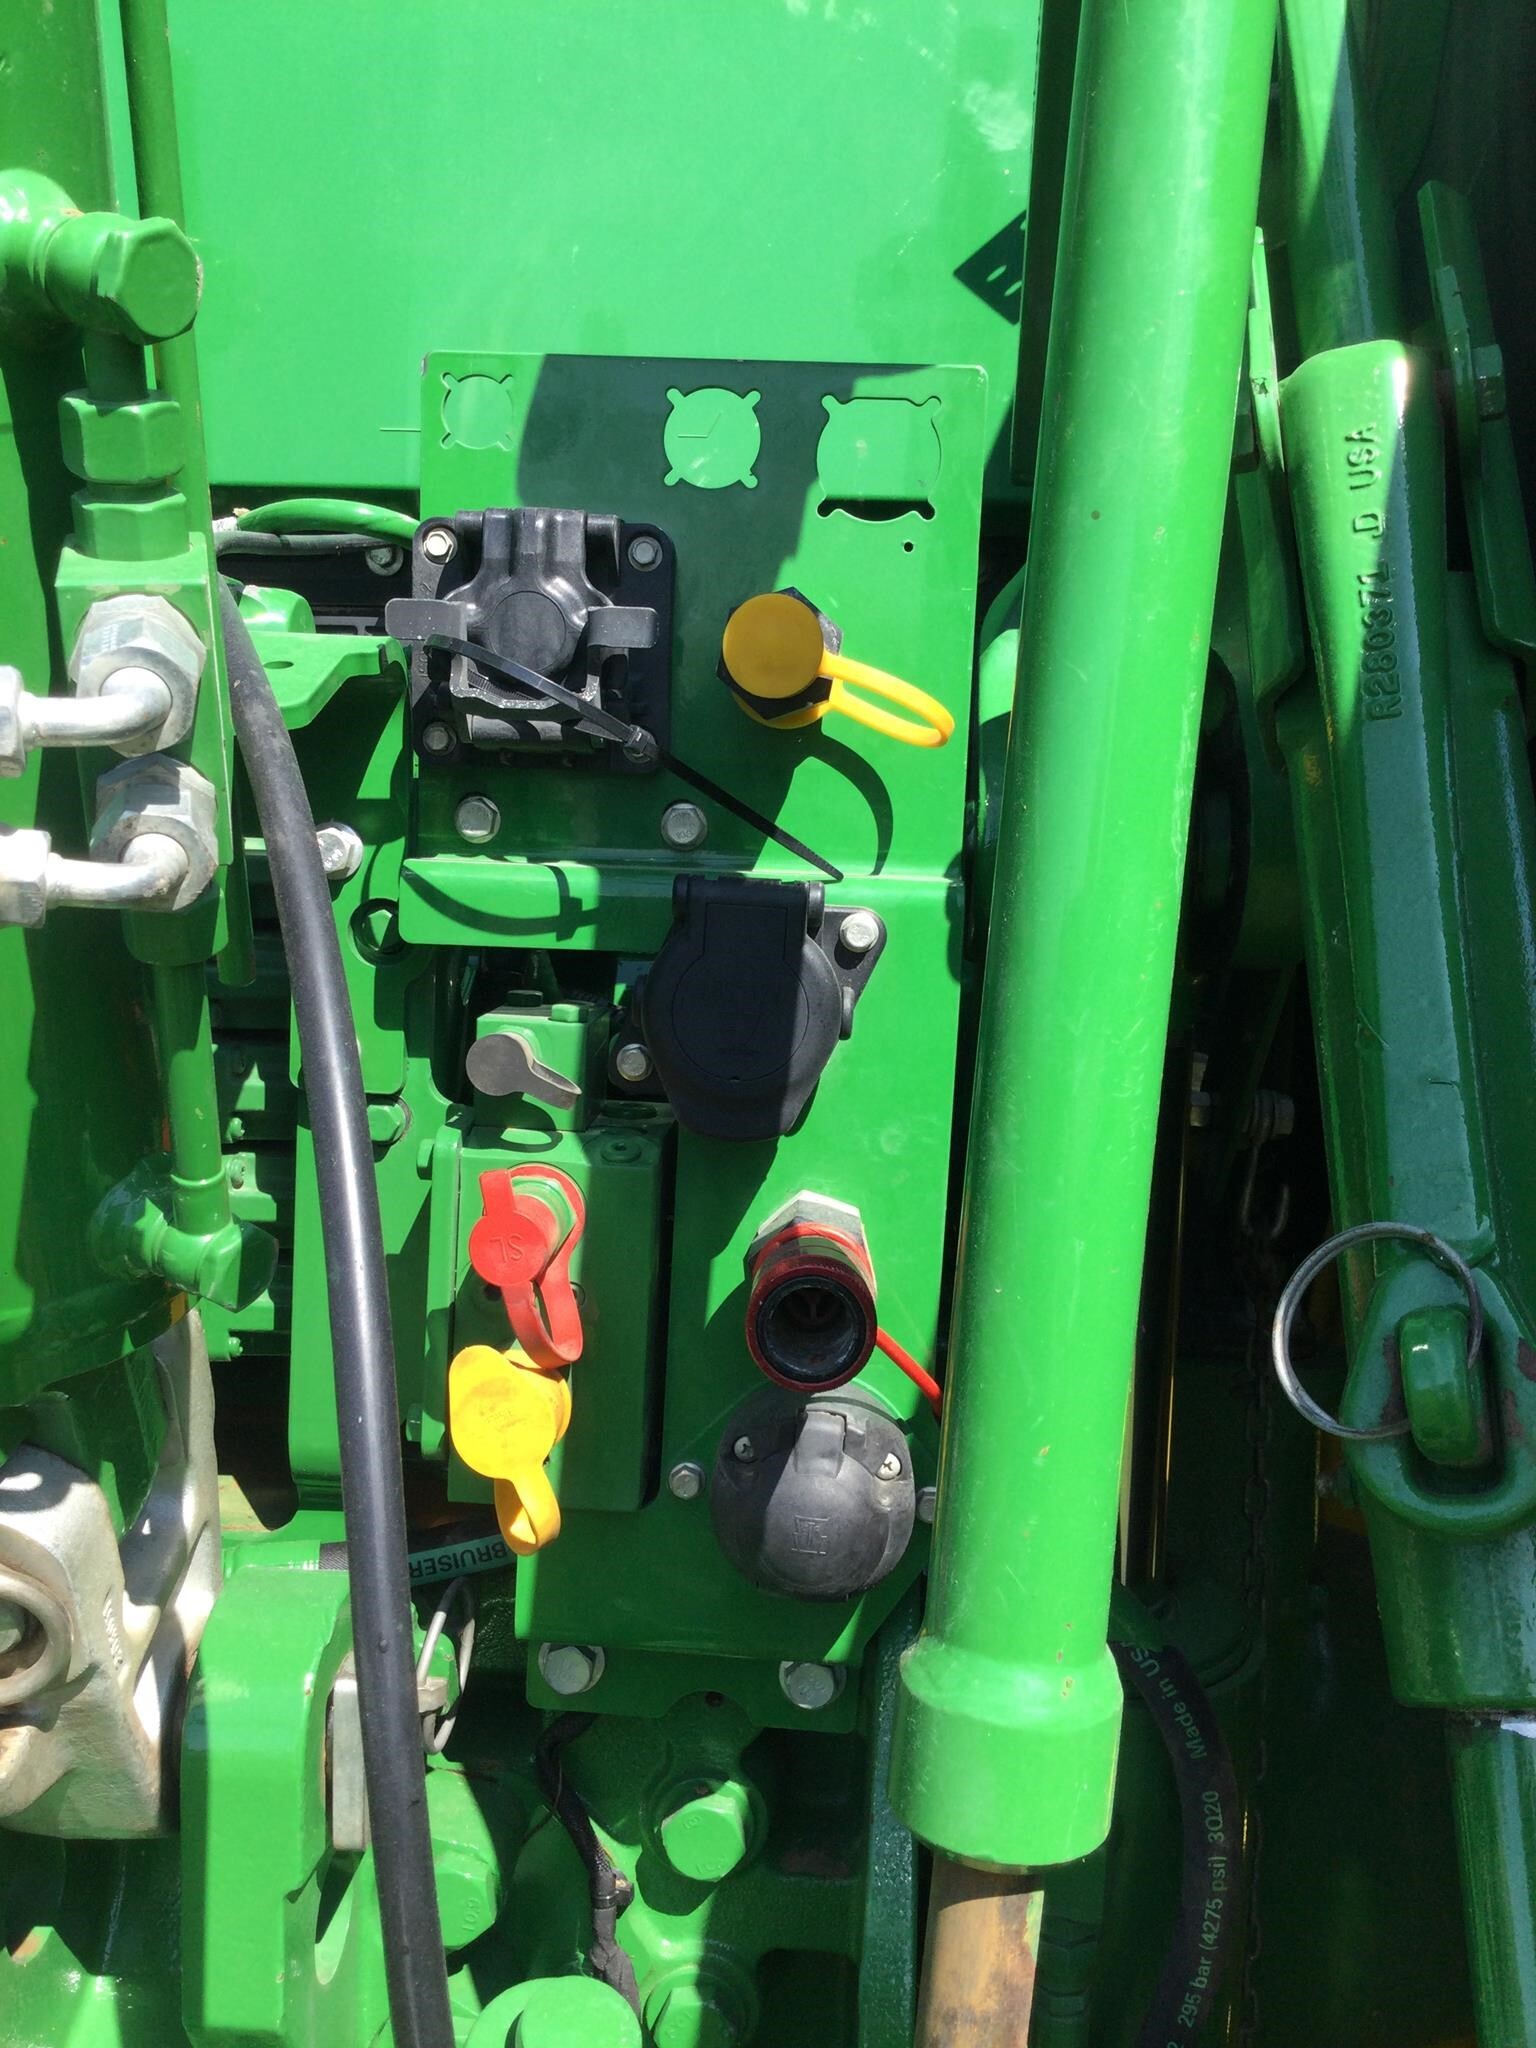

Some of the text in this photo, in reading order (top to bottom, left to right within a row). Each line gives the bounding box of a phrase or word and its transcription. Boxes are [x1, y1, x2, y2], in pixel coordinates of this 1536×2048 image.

[1345, 422, 1382, 490] USA
[1357, 559, 1403, 722] R280371
[408, 1541, 508, 1579] BRUISER
[1159, 1678, 1177, 1700] in
[1174, 1702, 1208, 1759] Made
[1203, 1791, 1225, 1843] 3Q20
[1208, 1856, 1228, 1892] psi)
[1198, 1898, 1224, 1951] (4275
[1189, 1957, 1213, 1989] bar
[1178, 1992, 1202, 2028] 295
